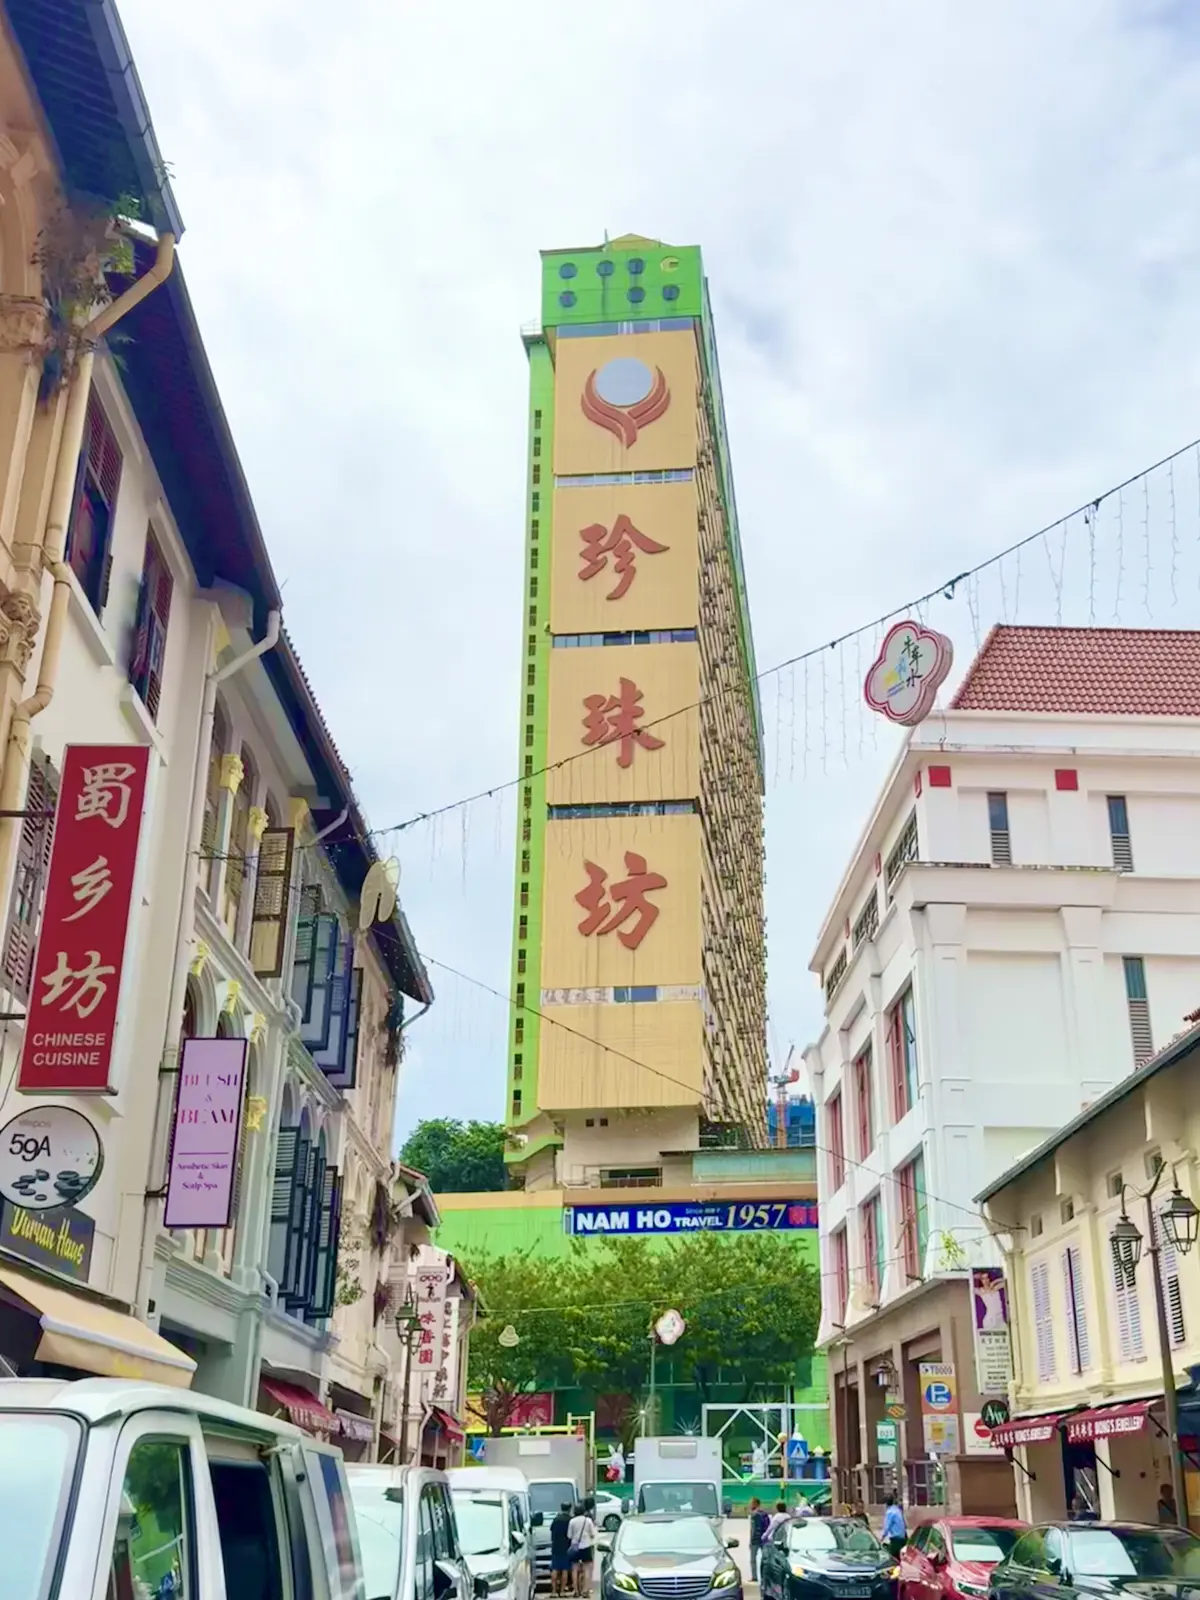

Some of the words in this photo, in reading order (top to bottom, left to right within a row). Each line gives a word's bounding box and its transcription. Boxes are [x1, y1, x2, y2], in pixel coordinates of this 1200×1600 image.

[575, 513, 672, 951] 珍珠坊
[41, 763, 137, 1020] 蜀乡坊
[32, 1032, 106, 1047] CHINESE
[32, 1052, 101, 1067] CUISINE
[9, 1133, 51, 1162] 59A
[576, 1211, 629, 1231] NAM
[637, 1209, 671, 1229] HO
[674, 1216, 723, 1228] TRAVEL
[725, 1203, 787, 1229] 1957
[56, 1217, 86, 1266] Haus
